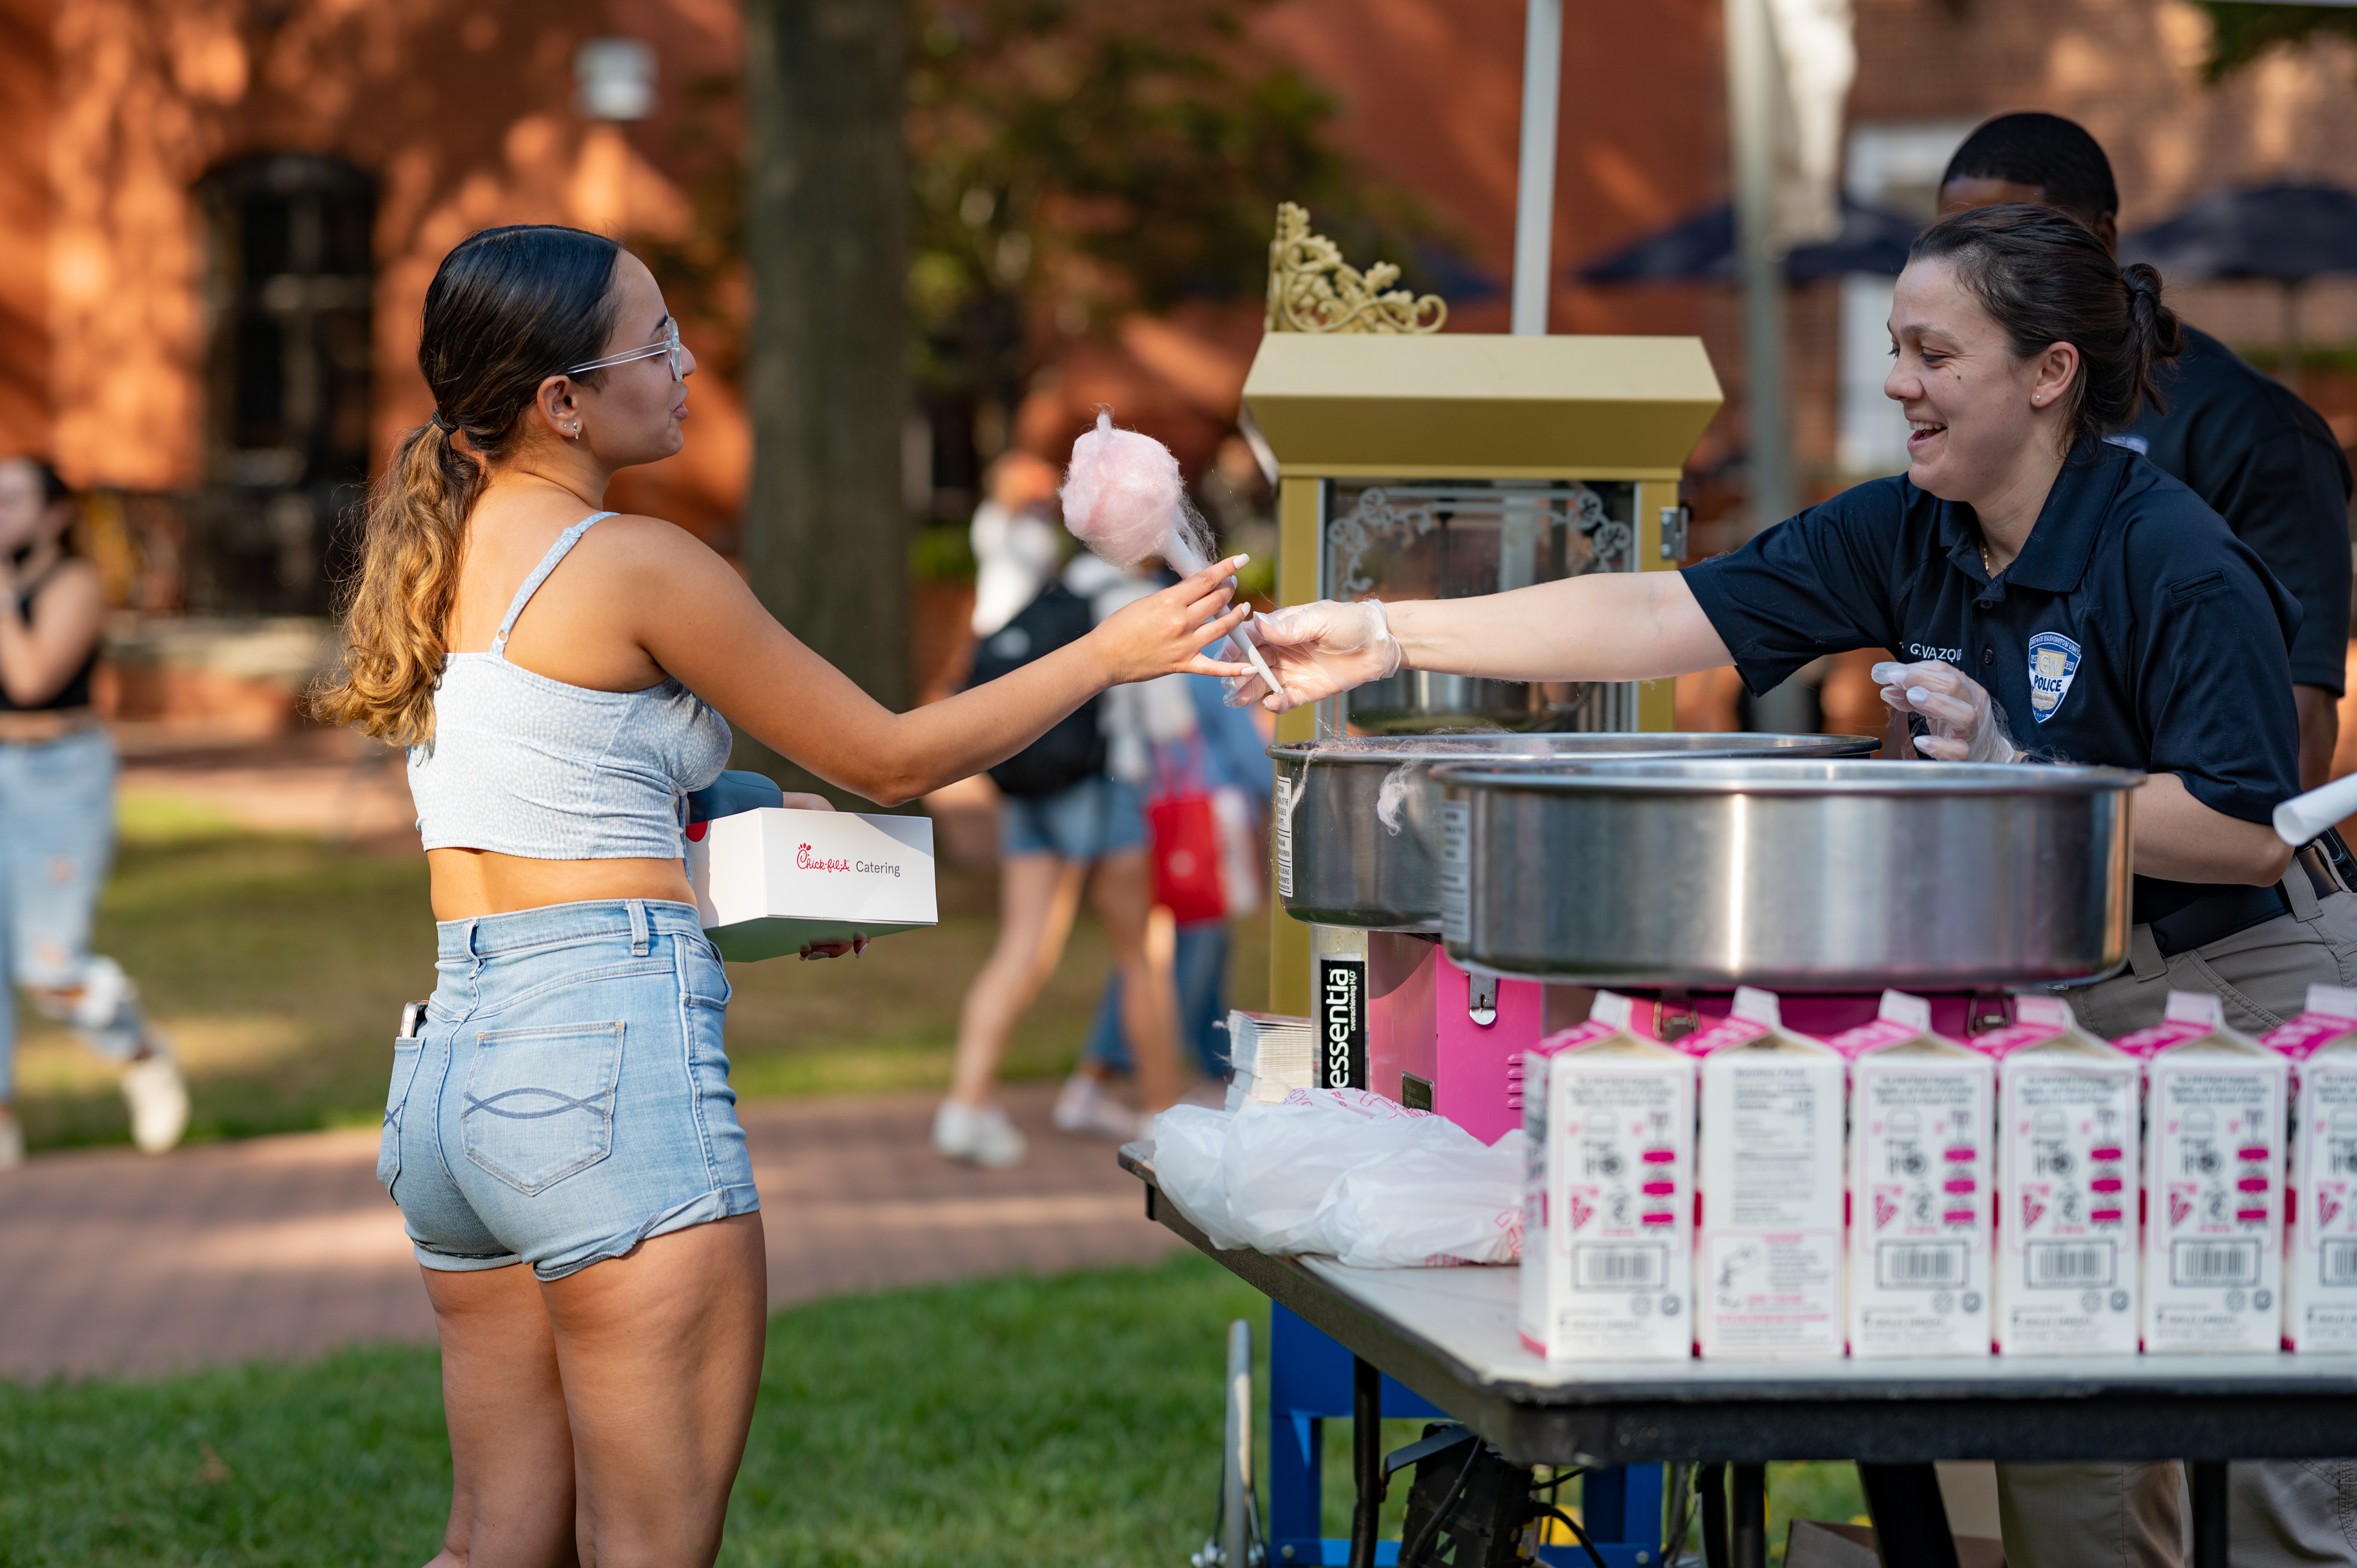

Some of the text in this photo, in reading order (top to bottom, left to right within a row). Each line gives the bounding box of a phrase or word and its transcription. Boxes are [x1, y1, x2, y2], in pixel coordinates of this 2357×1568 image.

[2043, 635, 2069, 648] WASHINGTON
[2039, 655, 2062, 674] GW
[2034, 674, 2062, 692] POLICE
[797, 843, 901, 877] Chick-fil-A Catering
[1349, 985, 1357, 1032] overachieving
[1325, 969, 1349, 1088] essentia
